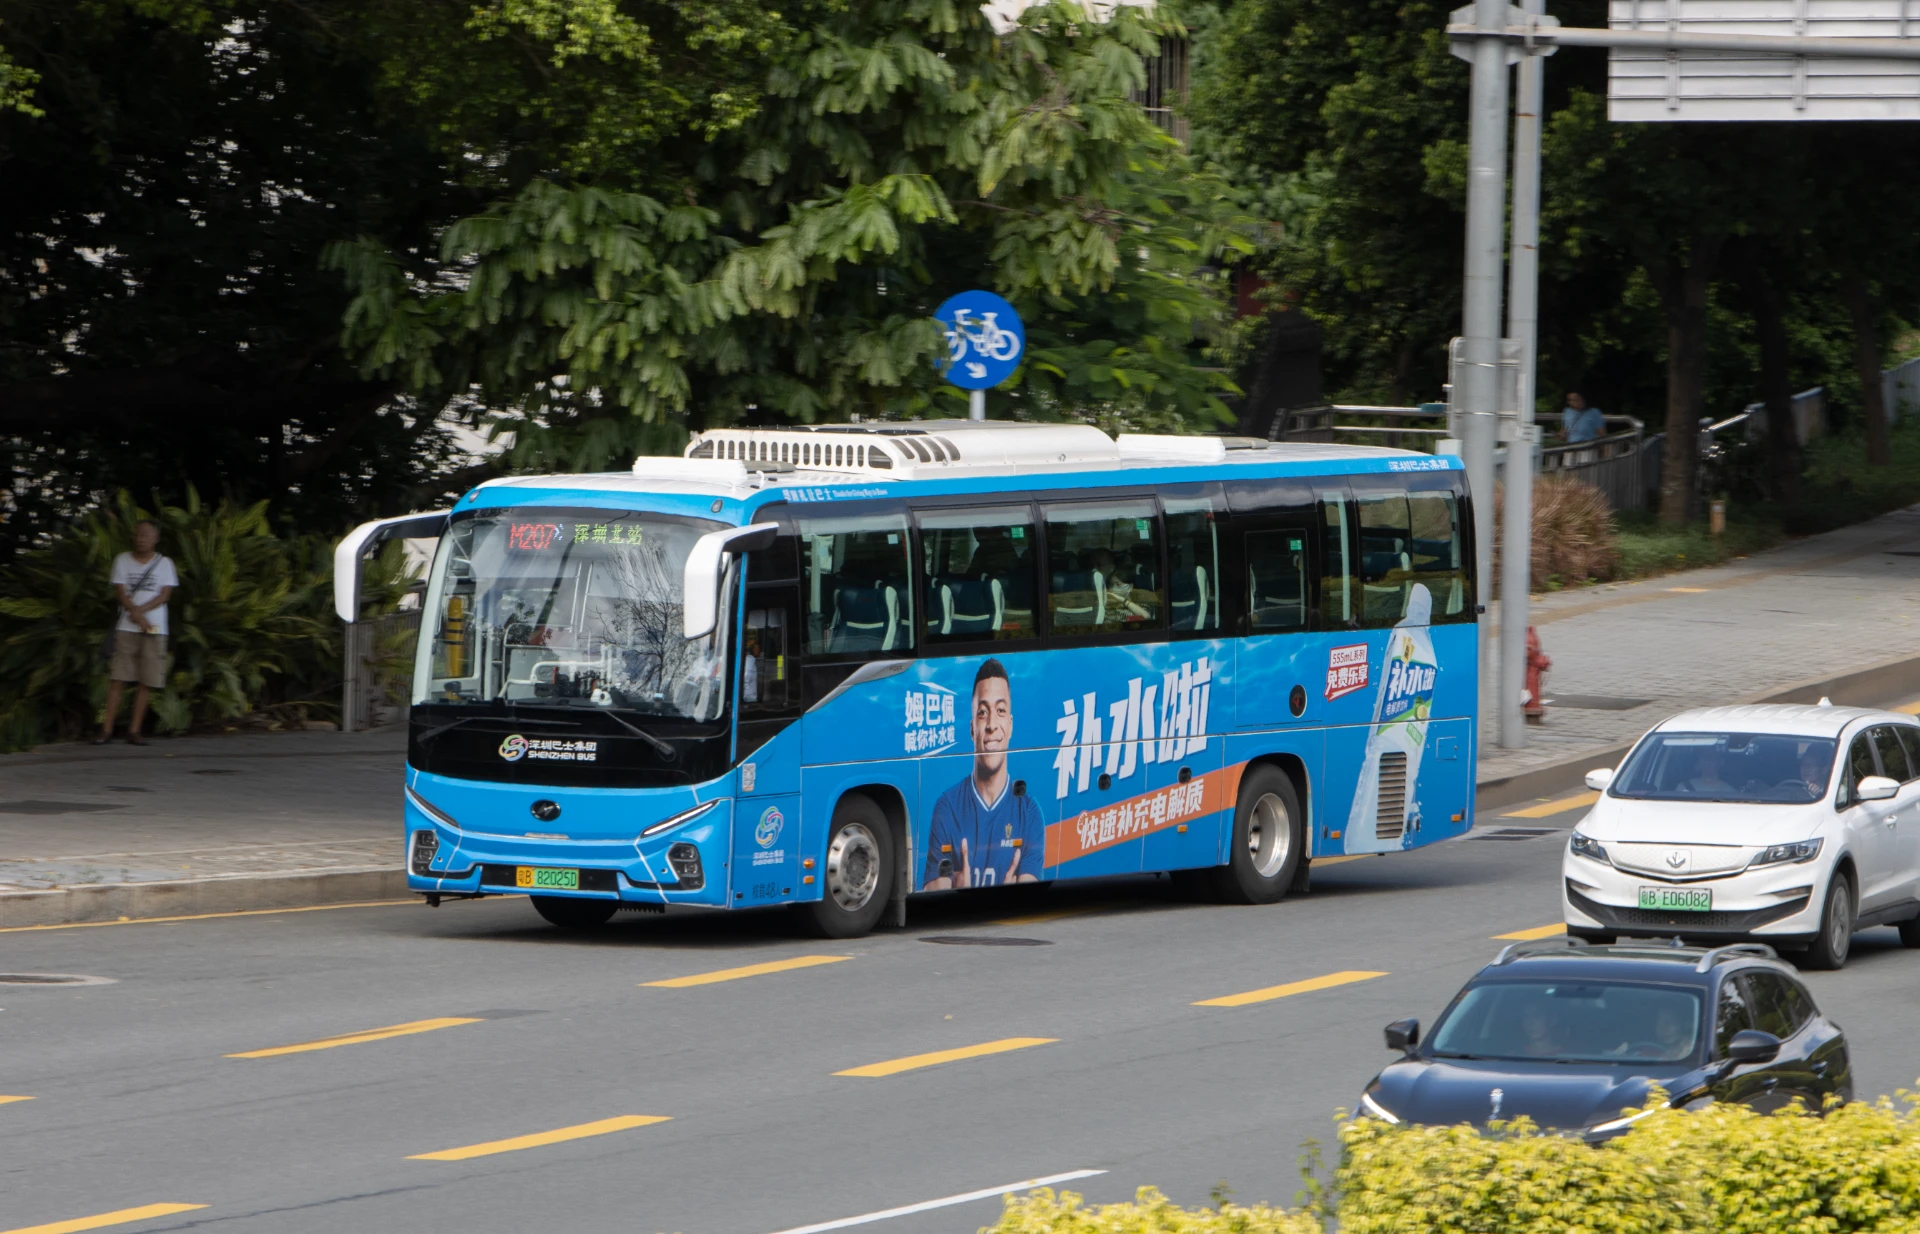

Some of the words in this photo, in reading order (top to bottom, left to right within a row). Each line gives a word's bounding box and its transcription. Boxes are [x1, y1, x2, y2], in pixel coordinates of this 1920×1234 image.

[1388, 459, 1450, 472] 深圳巴士集团
[509, 523, 557, 549] M207
[574, 523, 643, 545] 深圳北站
[1332, 648, 1366, 665] 555mL系列
[1327, 664, 1368, 689] 免费乐享
[1388, 661, 1436, 700] 补水啦
[904, 690, 955, 728] 姆巴佩
[904, 726, 955, 753] 喊你补水啦
[1053, 656, 1212, 800] 补水啦
[528, 750, 575, 760] SHENZHEN
[577, 753, 596, 761] BUS
[529, 739, 597, 752] 深圳巴士集团
[1081, 778, 1204, 850] 快速补充电解质
[537, 870, 577, 887] 82025D
[1662, 891, 1709, 908] E06082
